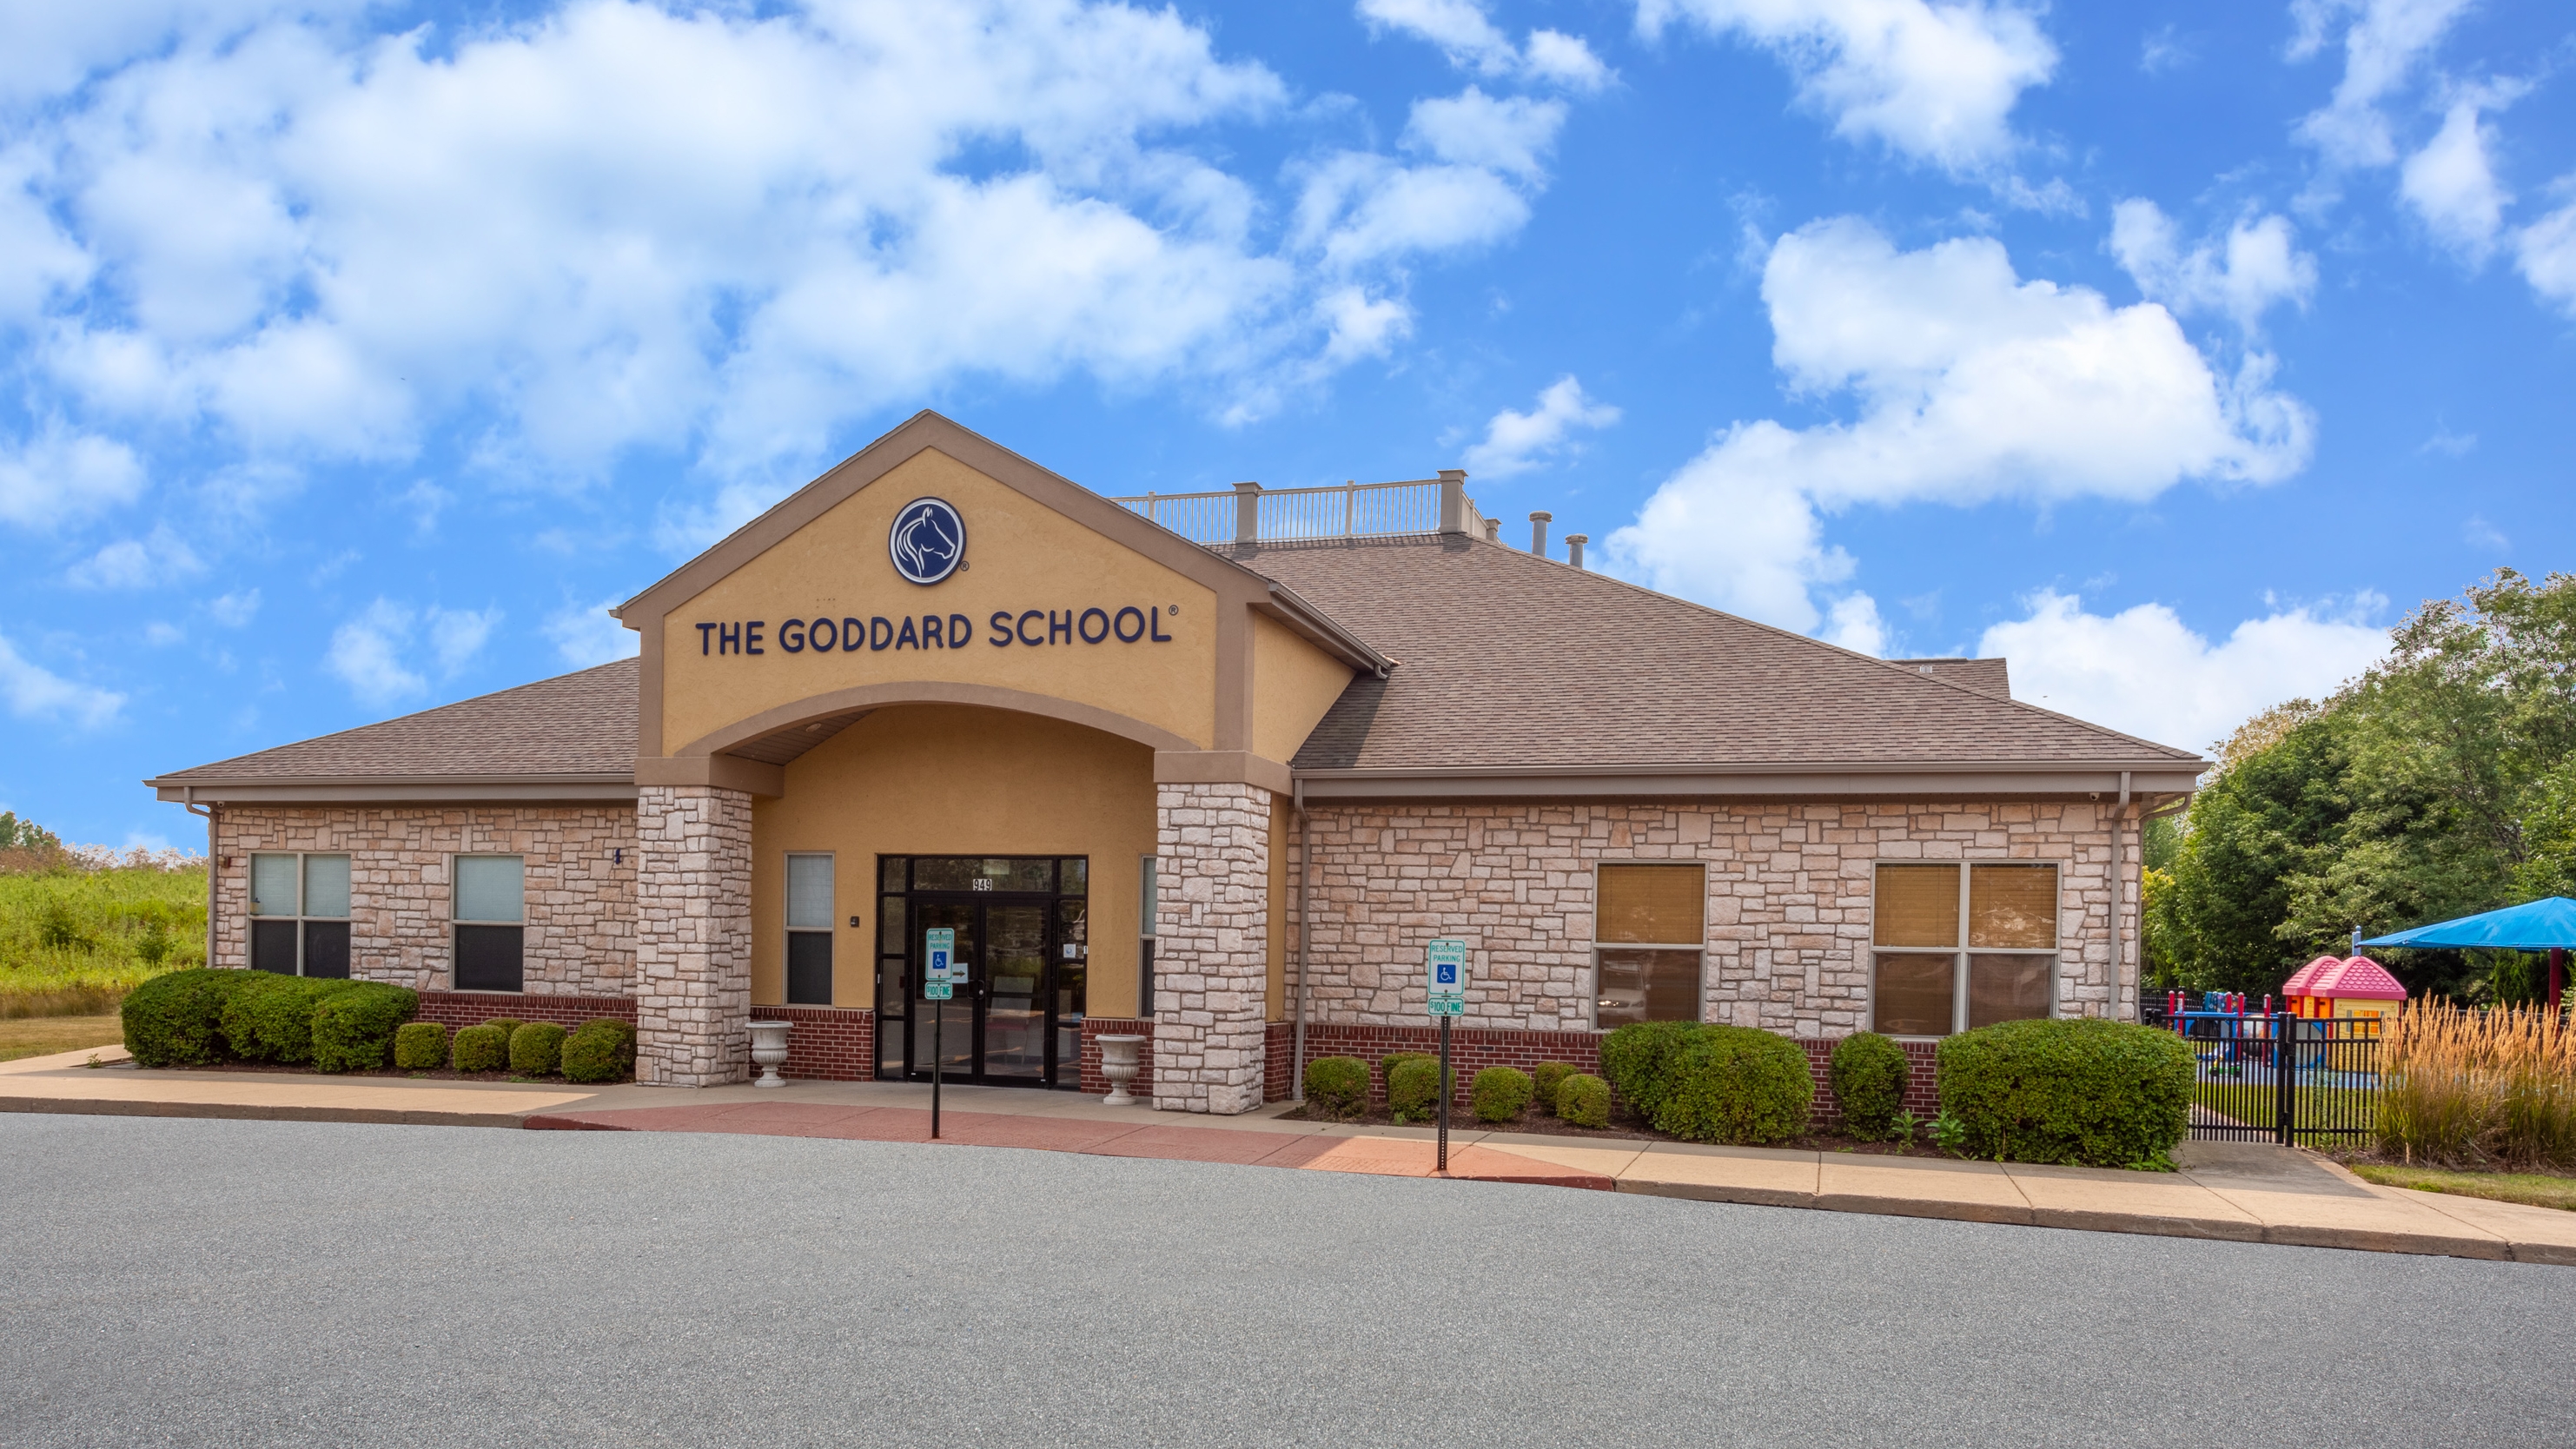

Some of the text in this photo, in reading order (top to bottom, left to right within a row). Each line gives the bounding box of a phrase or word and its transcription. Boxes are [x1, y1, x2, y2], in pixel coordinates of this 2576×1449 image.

[695, 620, 765, 656] THE
[778, 613, 972, 653] GODDARD
[974, 879, 991, 891] 949
[1431, 944, 1463, 953] RESERVED
[927, 986, 950, 996] $100 FINE
[1430, 1001, 1461, 1013] $100 FINE
